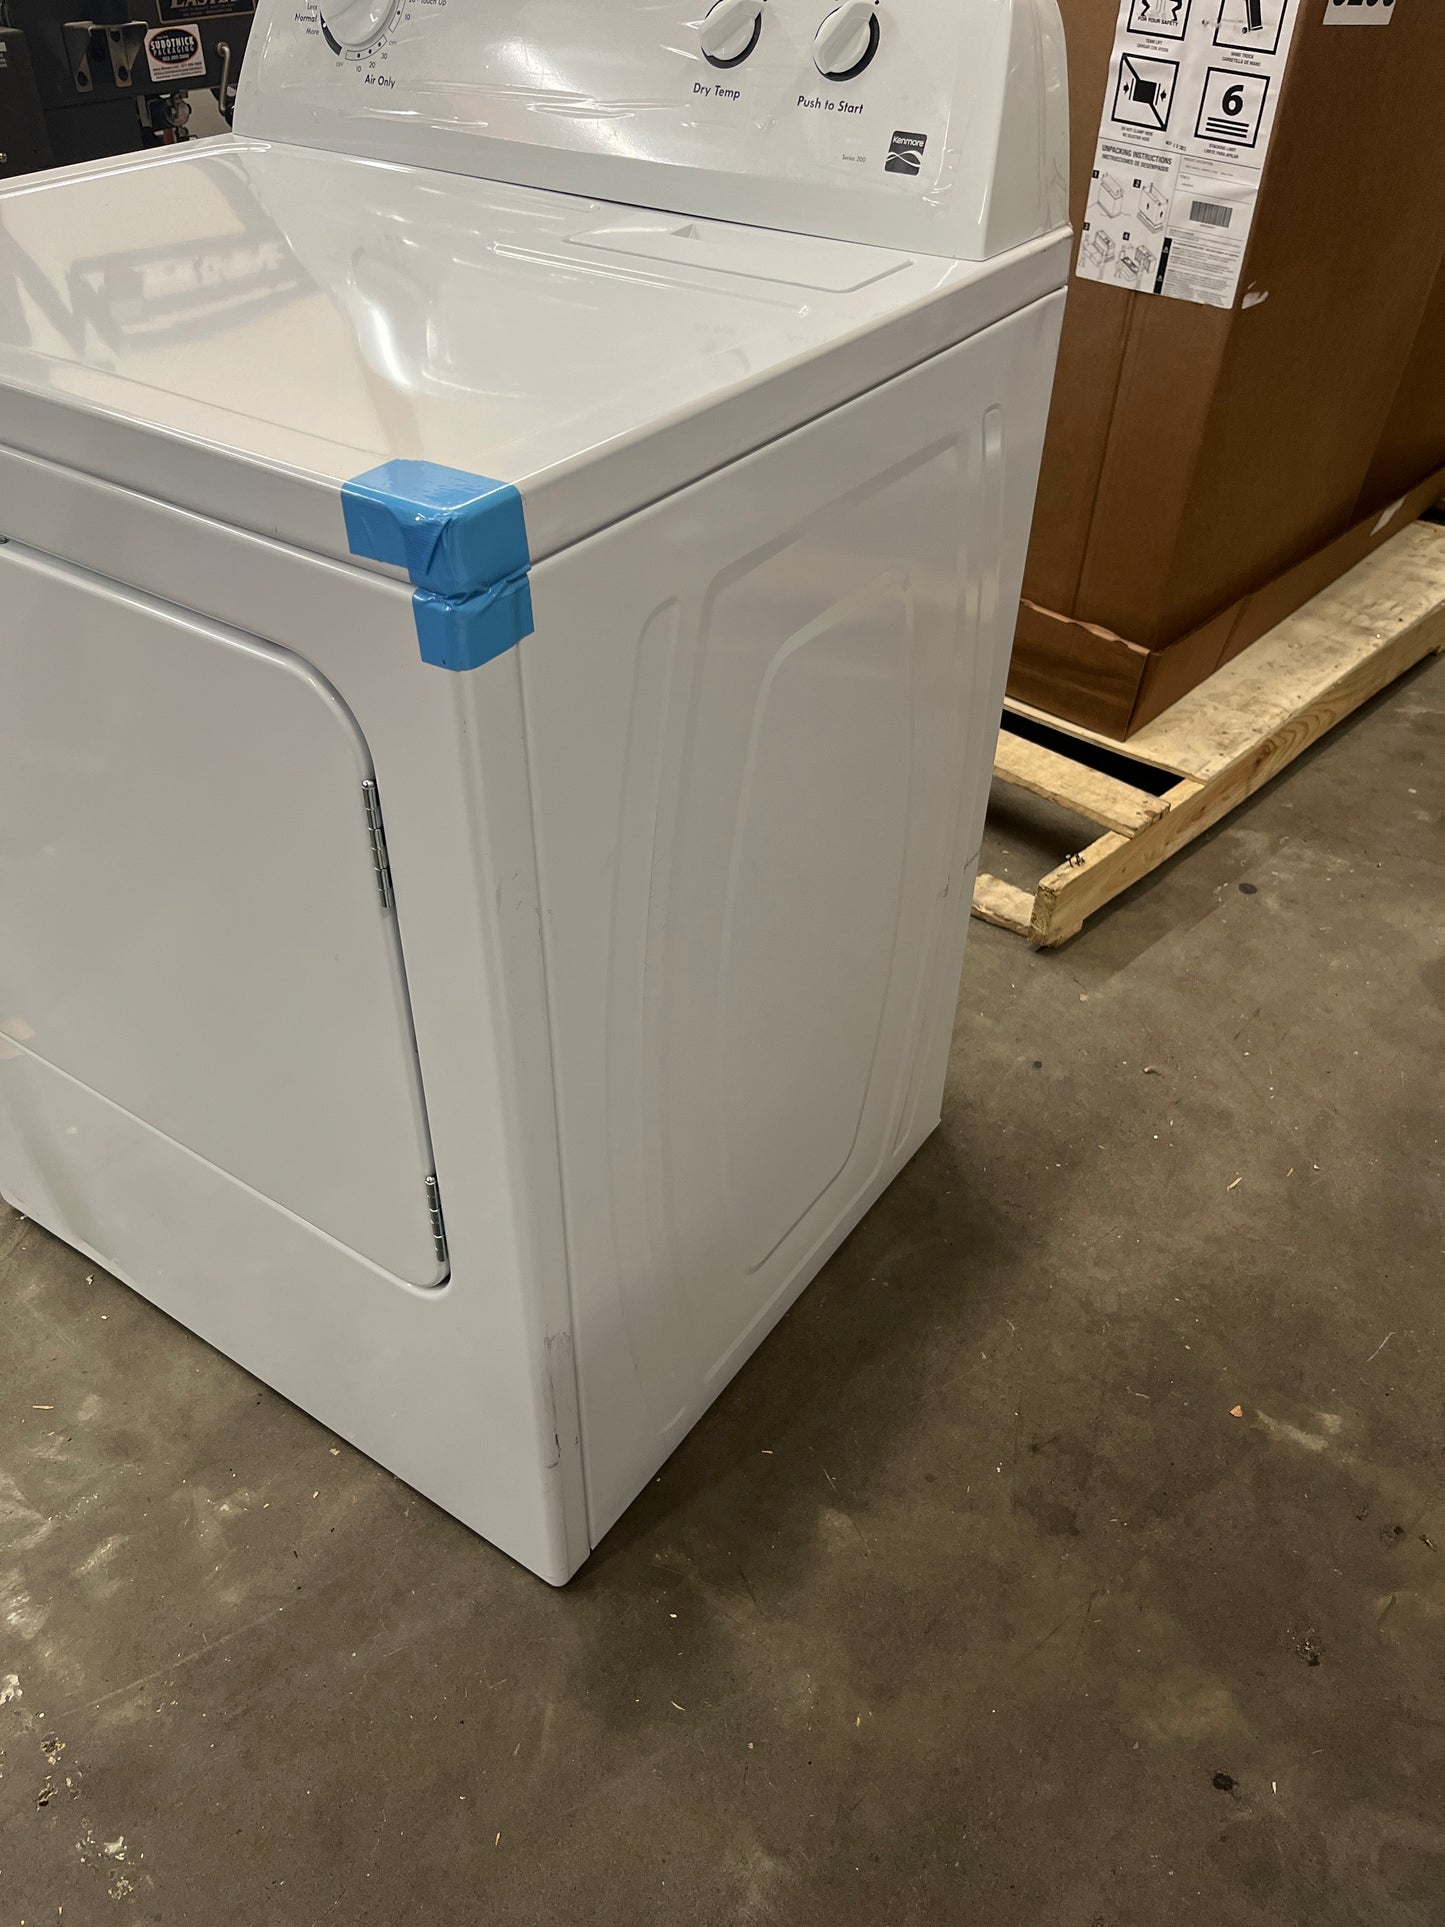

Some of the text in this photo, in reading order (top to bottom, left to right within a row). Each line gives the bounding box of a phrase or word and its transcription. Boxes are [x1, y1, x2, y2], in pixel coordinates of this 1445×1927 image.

[307, 2, 318, 11] Less
[294, 13, 318, 23] Normal
[404, 13, 411, 21] 10
[1161, 19, 1179, 27] SAFETY
[305, 28, 320, 36] More
[150, 36, 195, 50] SUBOTNICK
[153, 45, 195, 56] PACKAGING
[381, 52, 388, 60] 30
[355, 65, 362, 73] 10
[368, 61, 376, 69] 20
[364, 74, 396, 89] Air Only
[693, 82, 741, 101] Dry Temp
[796, 95, 864, 115] Push to Start
[1222, 84, 1244, 117] 6
[893, 135, 924, 148] Kenmore
[1101, 143, 1132, 158] UNPACKING
[1133, 150, 1172, 165] INSTRUCTIONS
